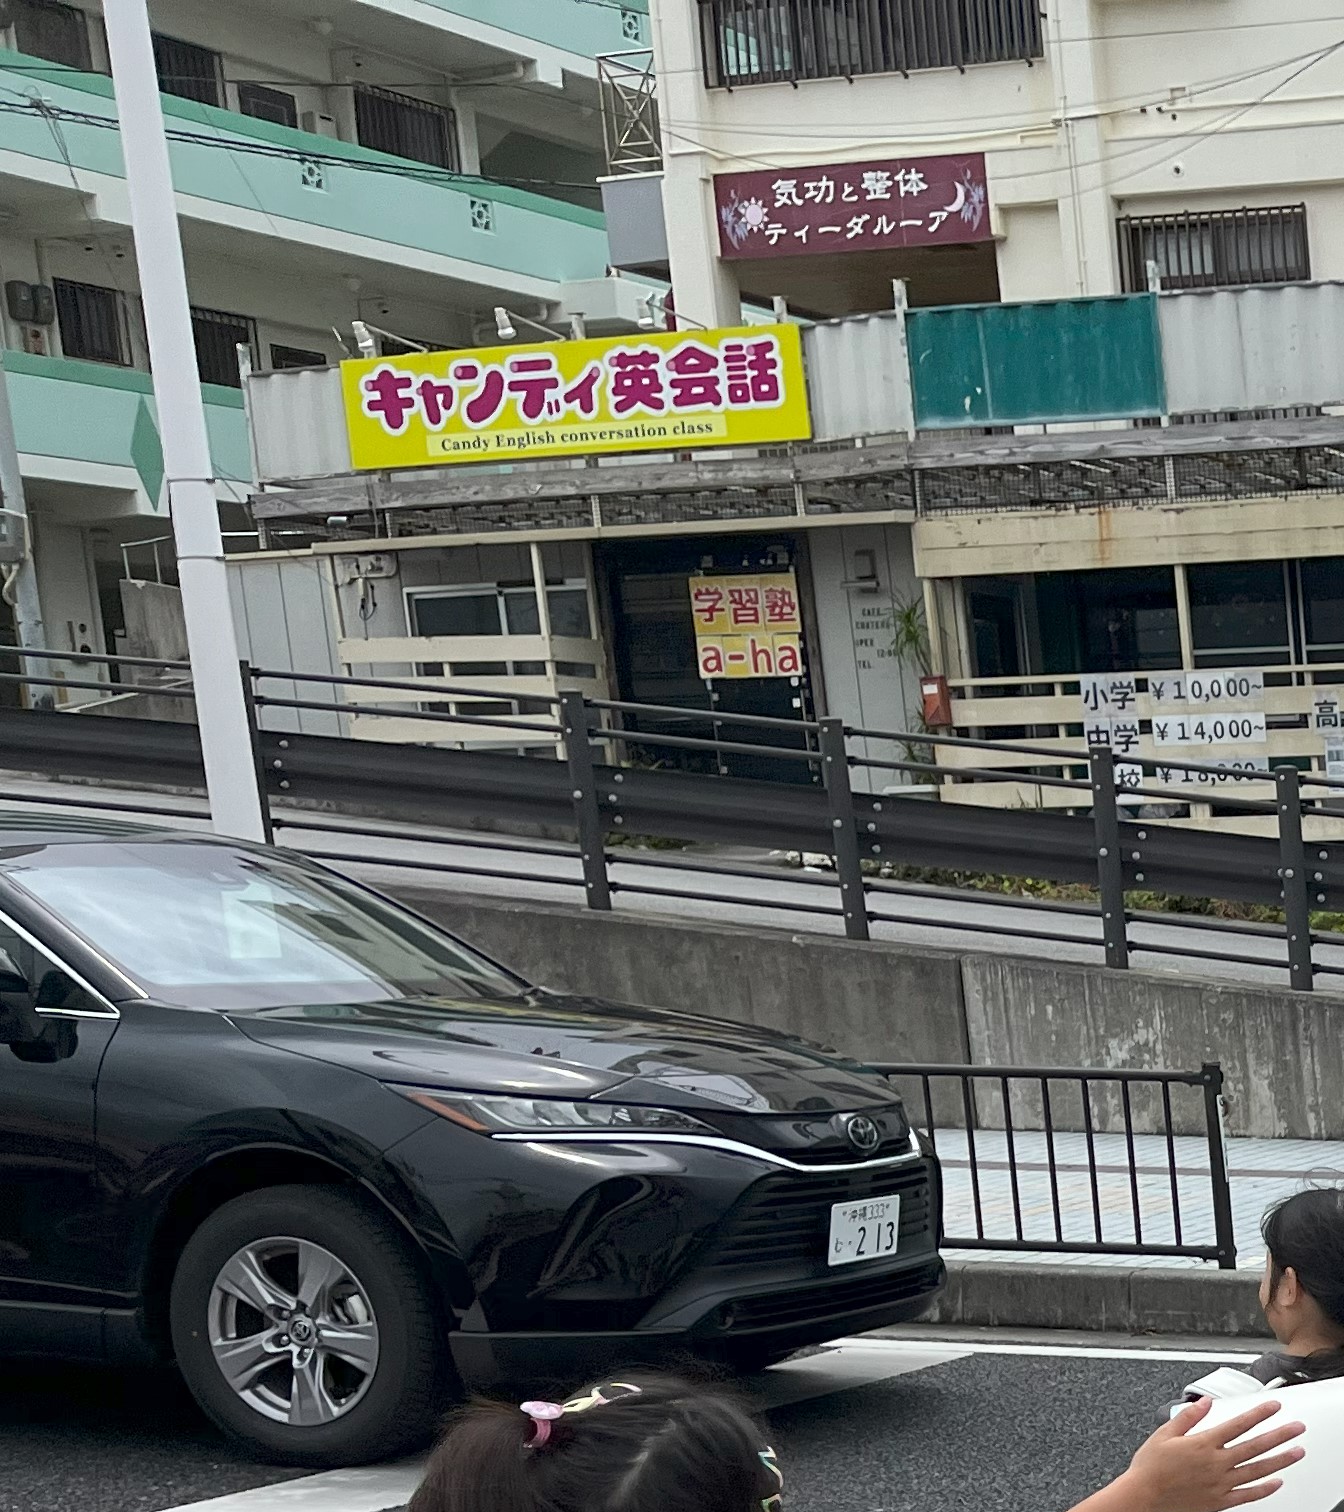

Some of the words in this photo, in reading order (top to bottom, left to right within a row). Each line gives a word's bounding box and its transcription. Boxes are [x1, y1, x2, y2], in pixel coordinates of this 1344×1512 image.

[771, 168, 928, 208] 気功と整体
[764, 209, 950, 246] ティーダルーア
[364, 340, 780, 430] キャンディ英会話
[441, 435, 490, 451] Candy
[496, 430, 556, 449] English
[560, 424, 668, 443] conversation
[672, 421, 714, 435] class
[693, 586, 797, 626] 学習塾
[701, 638, 799, 674] a-ha
[1083, 680, 1136, 711] 小学
[1087, 724, 1139, 753] 中学
